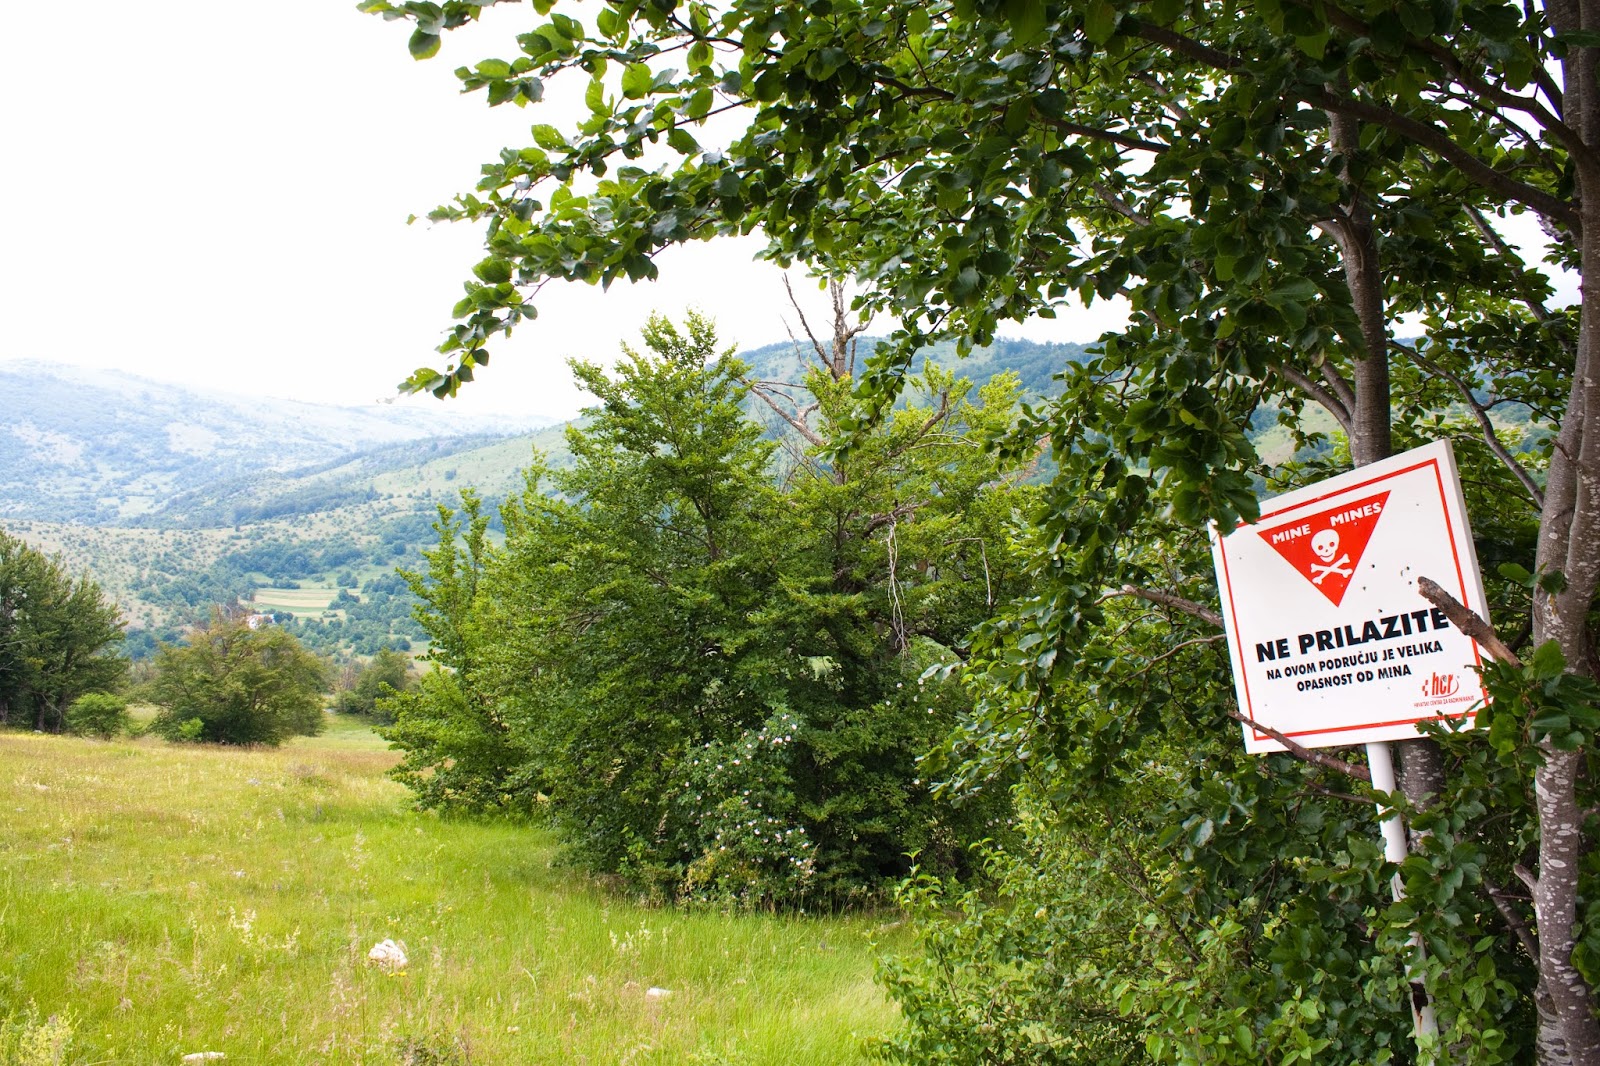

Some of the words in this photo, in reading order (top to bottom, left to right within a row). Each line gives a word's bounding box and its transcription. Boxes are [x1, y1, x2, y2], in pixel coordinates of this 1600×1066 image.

[1272, 524, 1311, 544] MINE
[1330, 502, 1382, 527] MINES
[1255, 638, 1291, 663] NE
[1298, 607, 1450, 655] PRILAZITE
[1266, 667, 1282, 680] NA
[1284, 662, 1317, 677] OVOM
[1319, 651, 1378, 672] PODRUČJU
[1382, 649, 1395, 662] JE
[1397, 640, 1443, 658] VELIKA
[1297, 673, 1353, 692] OPASNOST
[1356, 670, 1374, 683] OD
[1378, 664, 1412, 680] MINA
